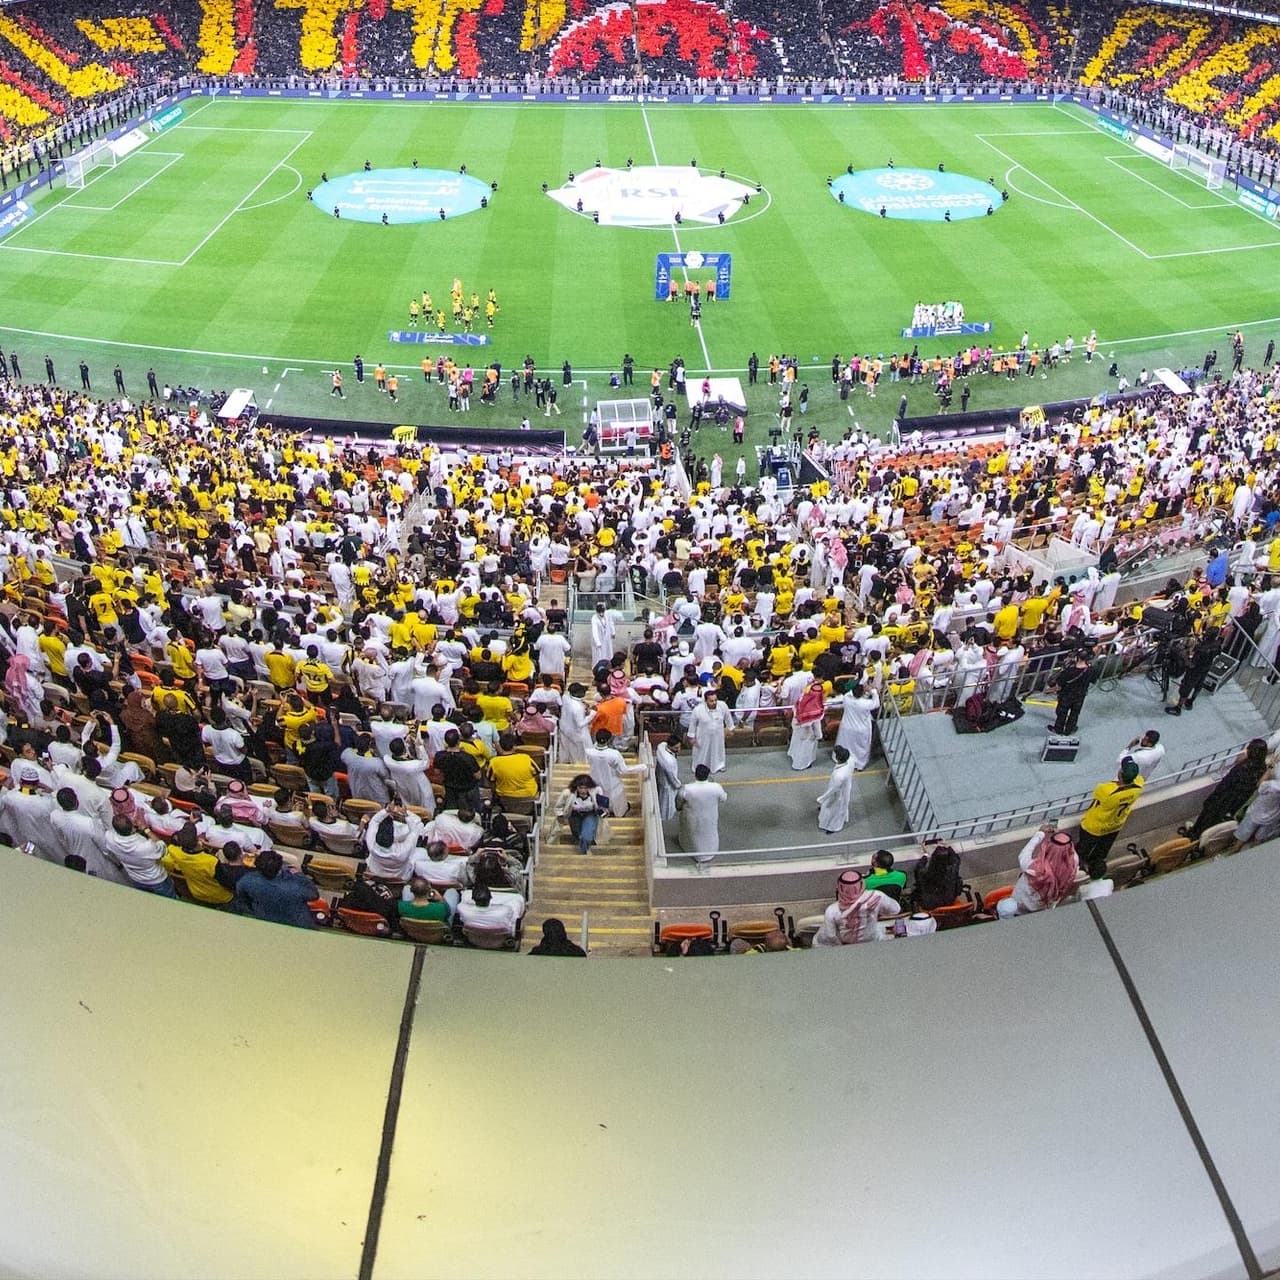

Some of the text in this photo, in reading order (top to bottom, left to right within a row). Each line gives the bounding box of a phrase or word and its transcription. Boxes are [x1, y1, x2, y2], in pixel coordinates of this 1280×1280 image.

[620, 187, 688, 198] RSL
[99, 603, 107, 614] 7
[1118, 802, 1130, 818] 7
